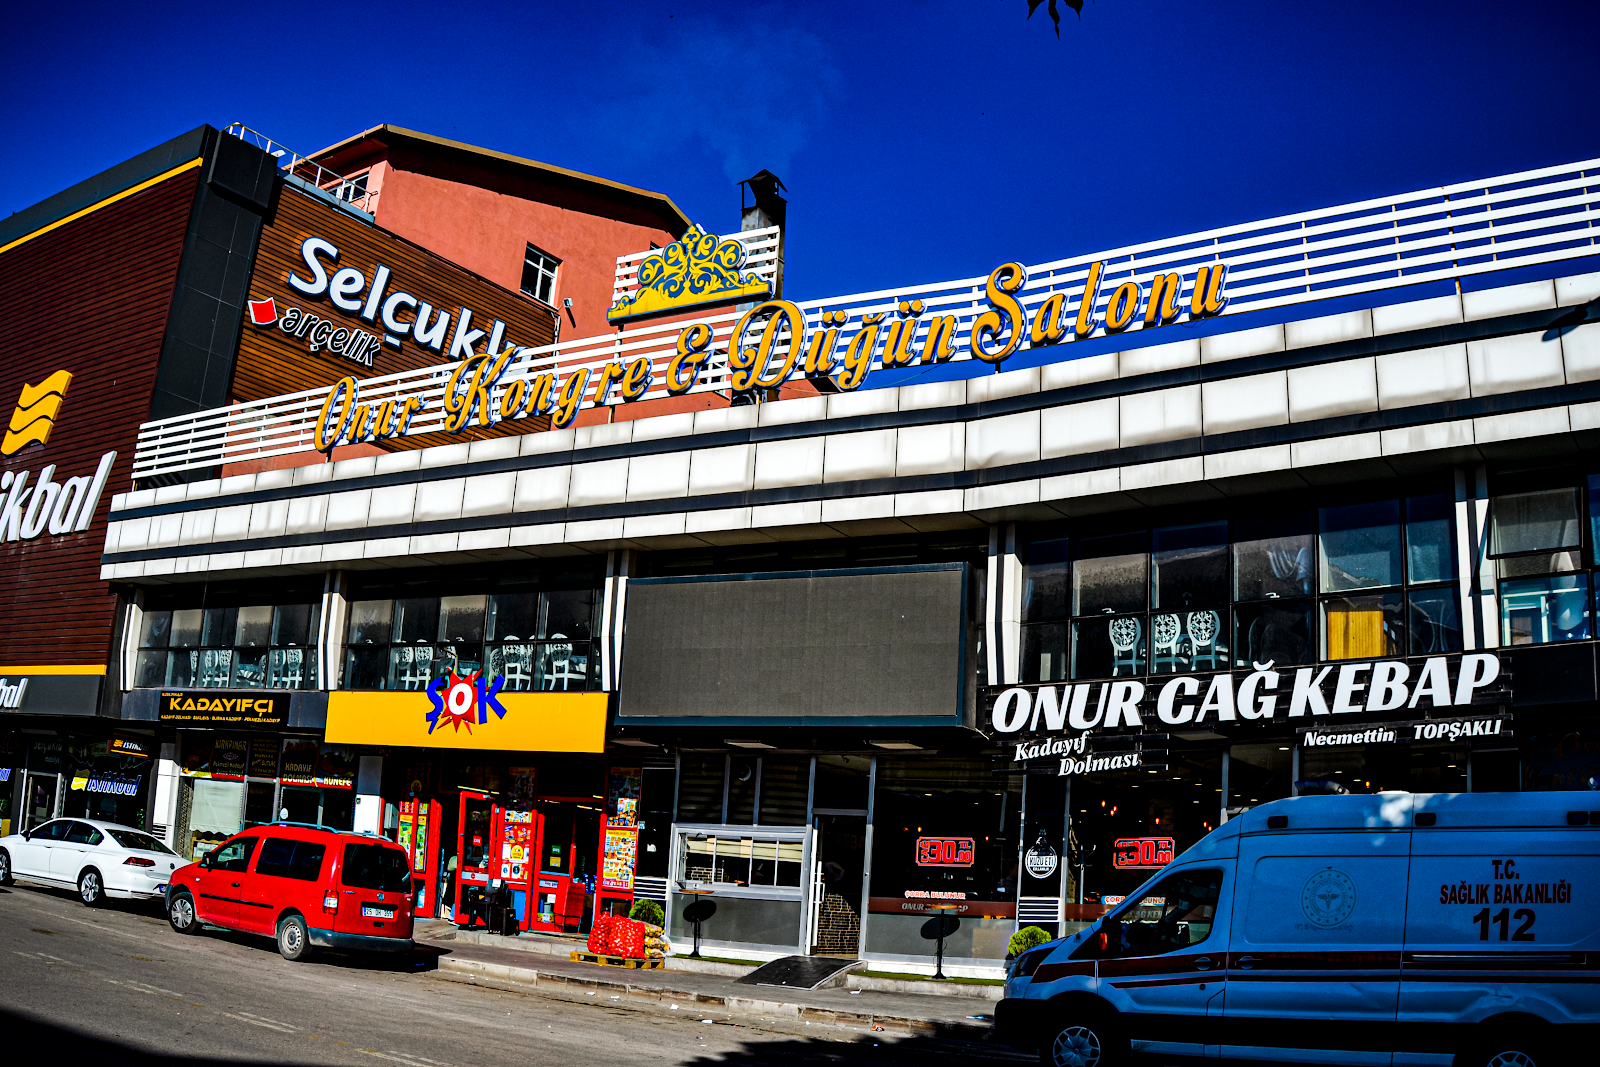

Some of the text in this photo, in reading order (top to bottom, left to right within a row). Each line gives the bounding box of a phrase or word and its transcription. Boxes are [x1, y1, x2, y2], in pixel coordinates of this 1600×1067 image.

[279, 306, 381, 367] arçelik
[313, 376, 428, 453] Onur
[444, 346, 654, 430] Kongre
[666, 323, 713, 395] &
[728, 299, 960, 392] Düğün
[971, 262, 1231, 363] Salonu
[426, 674, 507, 735] ŞOK
[992, 652, 1501, 733] ONUR CAĞ KEBAP
[170, 698, 274, 717] KADAYIFÇI
[1014, 731, 1089, 762] Kadayıf
[1304, 719, 1502, 747] Necmettin TOPŞAKLI
[1058, 754, 1139, 777] Dolması
[1492, 859, 1520, 880] T.C.
[931, 892, 966, 900] BULUNUR
[1440, 879, 1571, 905] SAĞLIK BAKANLIĞI
[1473, 907, 1536, 942] 112
